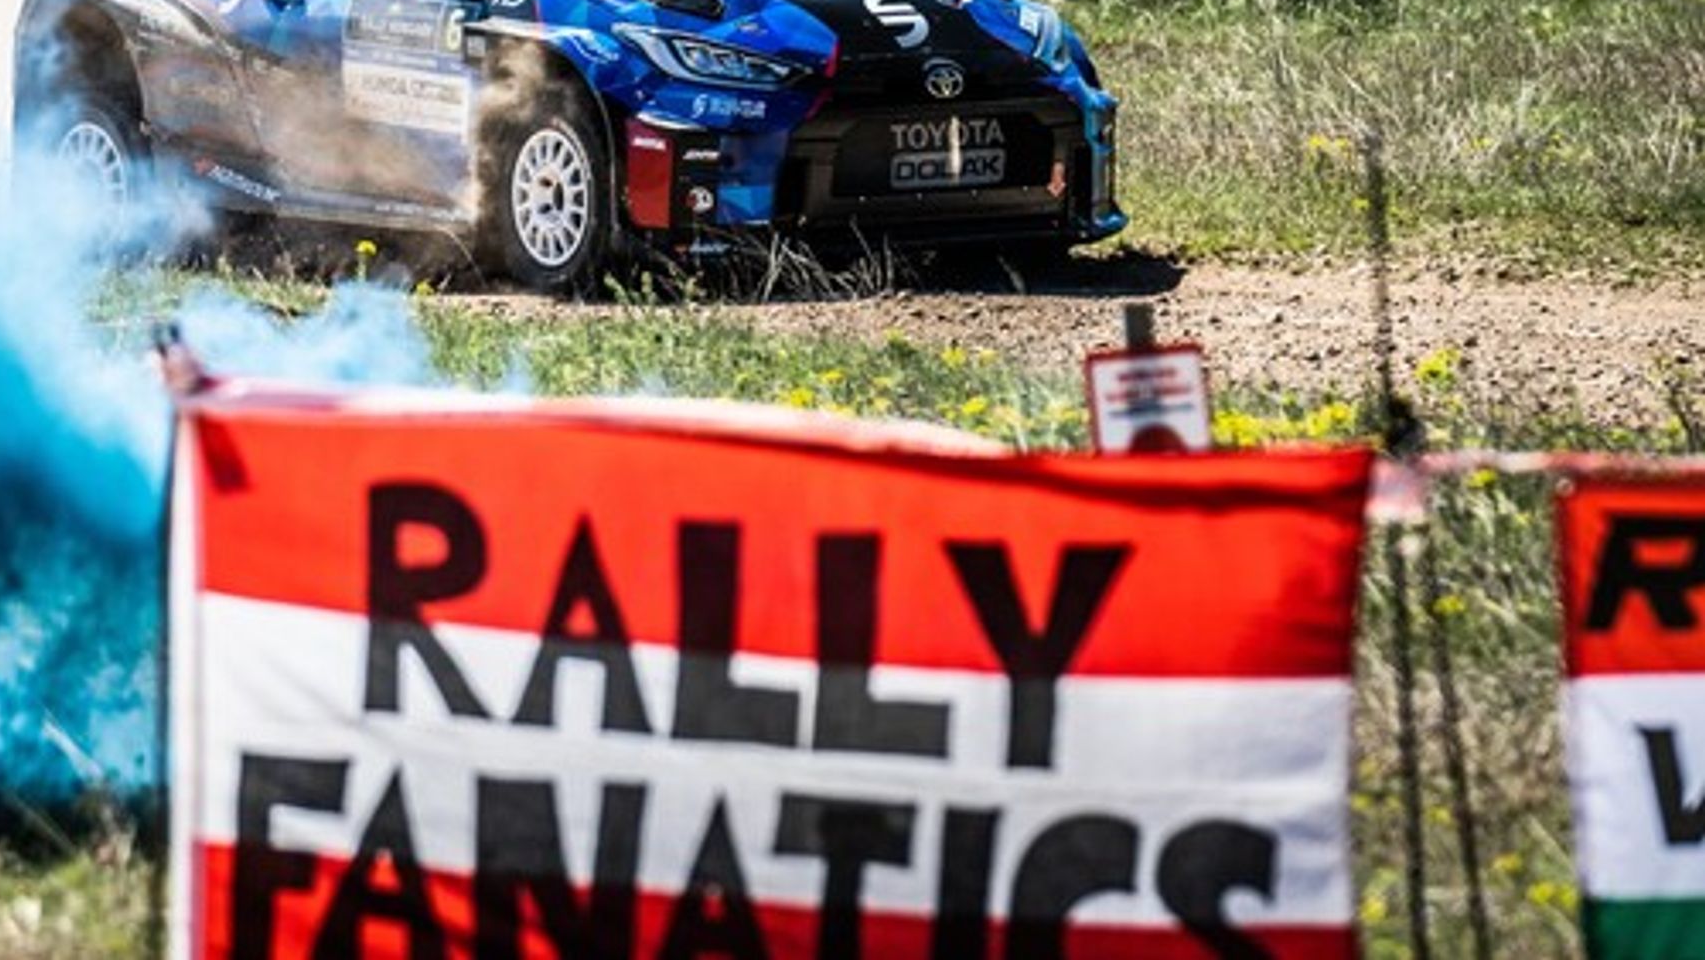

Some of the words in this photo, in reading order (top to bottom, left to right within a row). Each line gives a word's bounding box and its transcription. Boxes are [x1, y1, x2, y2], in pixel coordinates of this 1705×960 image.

[446, 8, 466, 51] 6
[891, 117, 1005, 150] TOYOTA
[364, 480, 1135, 771] RALLY
[230, 750, 1278, 960] FANATICS
